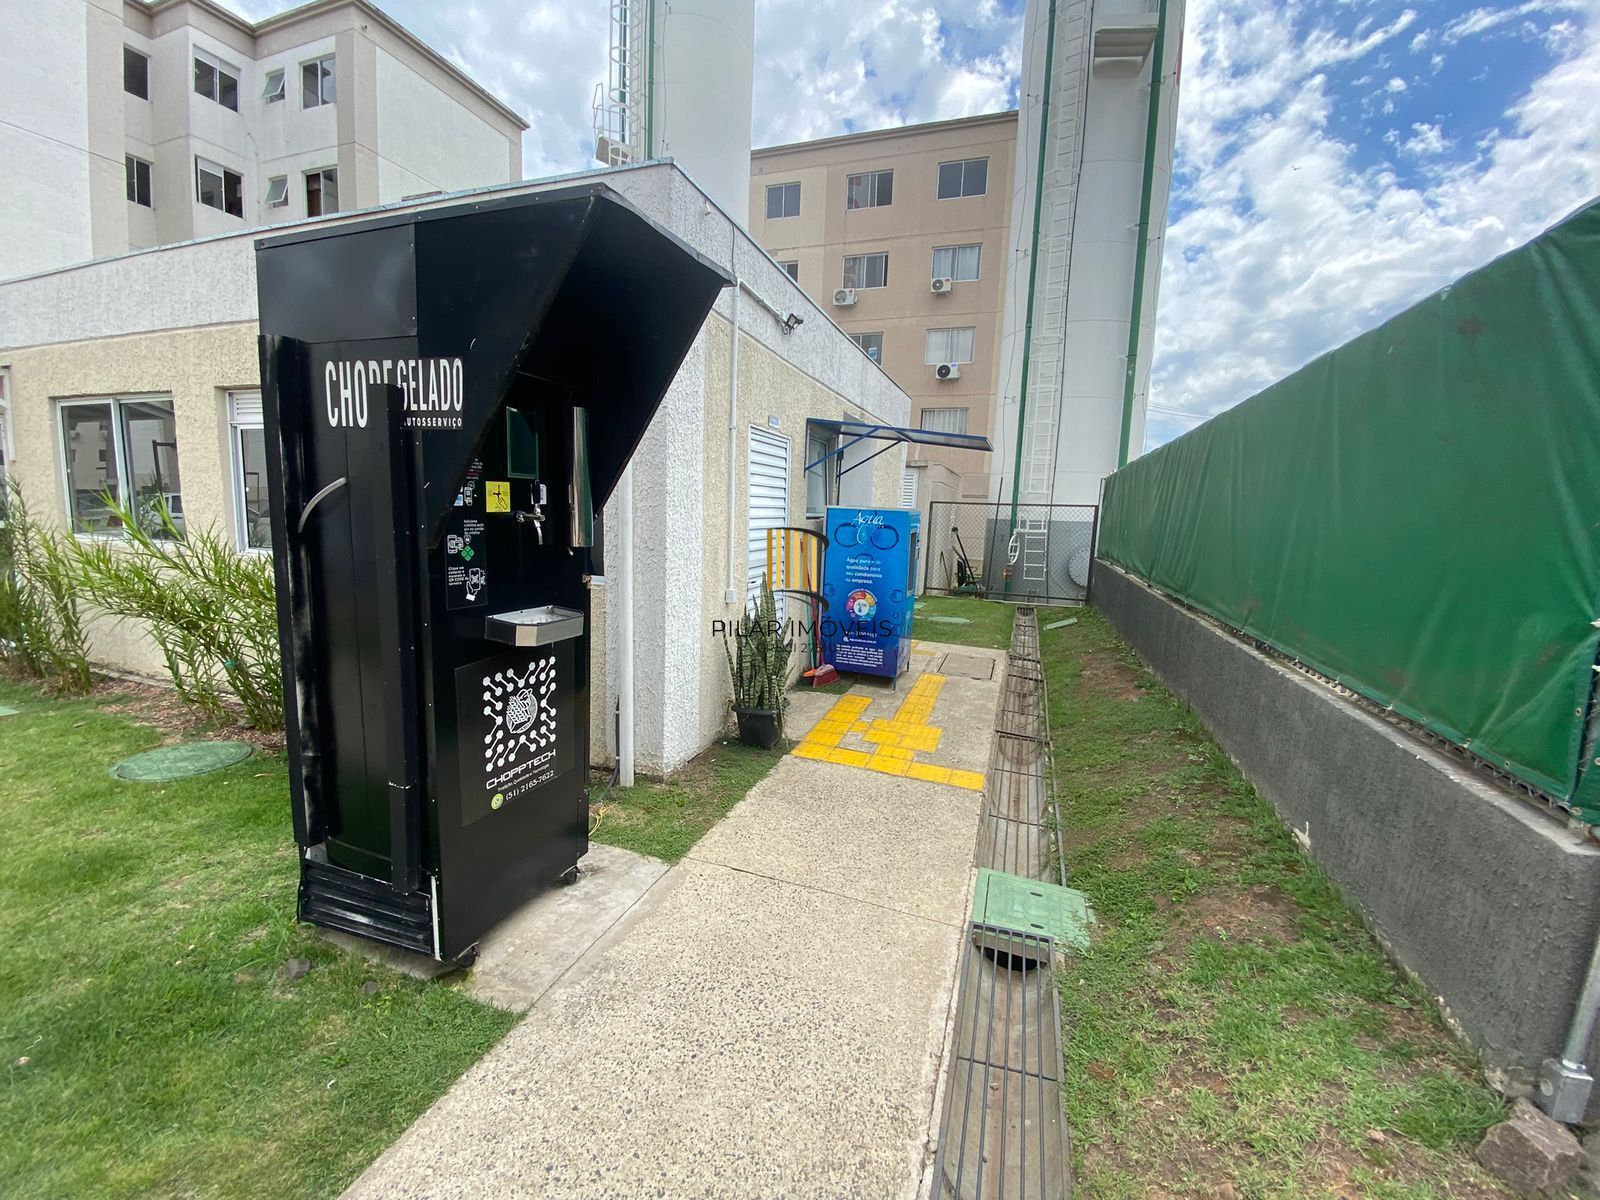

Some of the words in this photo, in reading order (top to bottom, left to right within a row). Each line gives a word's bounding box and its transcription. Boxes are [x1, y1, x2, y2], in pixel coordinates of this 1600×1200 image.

[397, 358, 463, 411] GELADO
[404, 417, 462, 429] UTOSSERVIÇO
[486, 748, 556, 790] CHOPPTECH
[506, 788, 519, 801] (51)
[520, 770, 554, 793] 2165-7622
